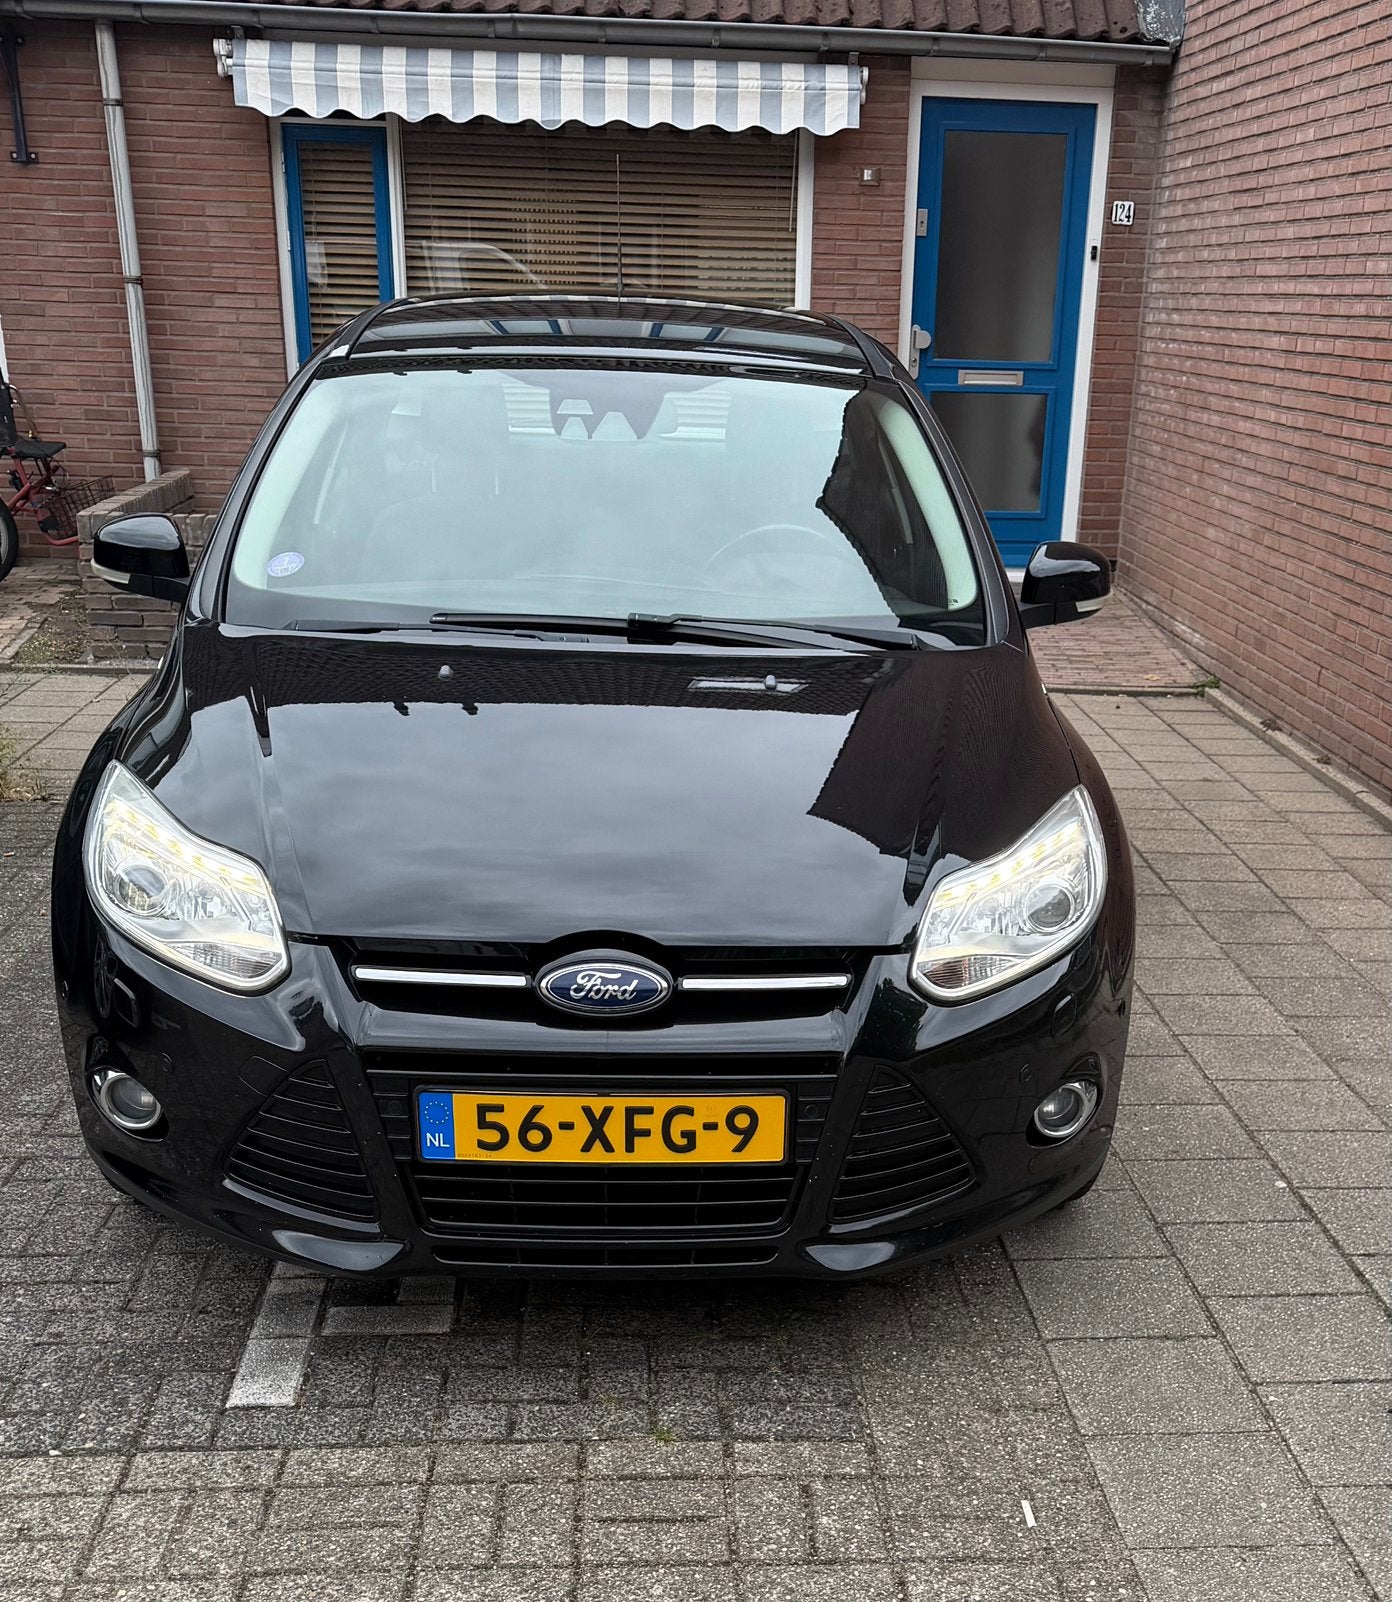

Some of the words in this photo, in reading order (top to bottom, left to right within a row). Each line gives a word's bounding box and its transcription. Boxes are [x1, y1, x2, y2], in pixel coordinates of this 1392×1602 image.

[1113, 203, 1132, 223] 124
[569, 970, 639, 1000] Ford
[426, 1132, 450, 1147] NL
[475, 1103, 760, 1153] 56-XFG-9
